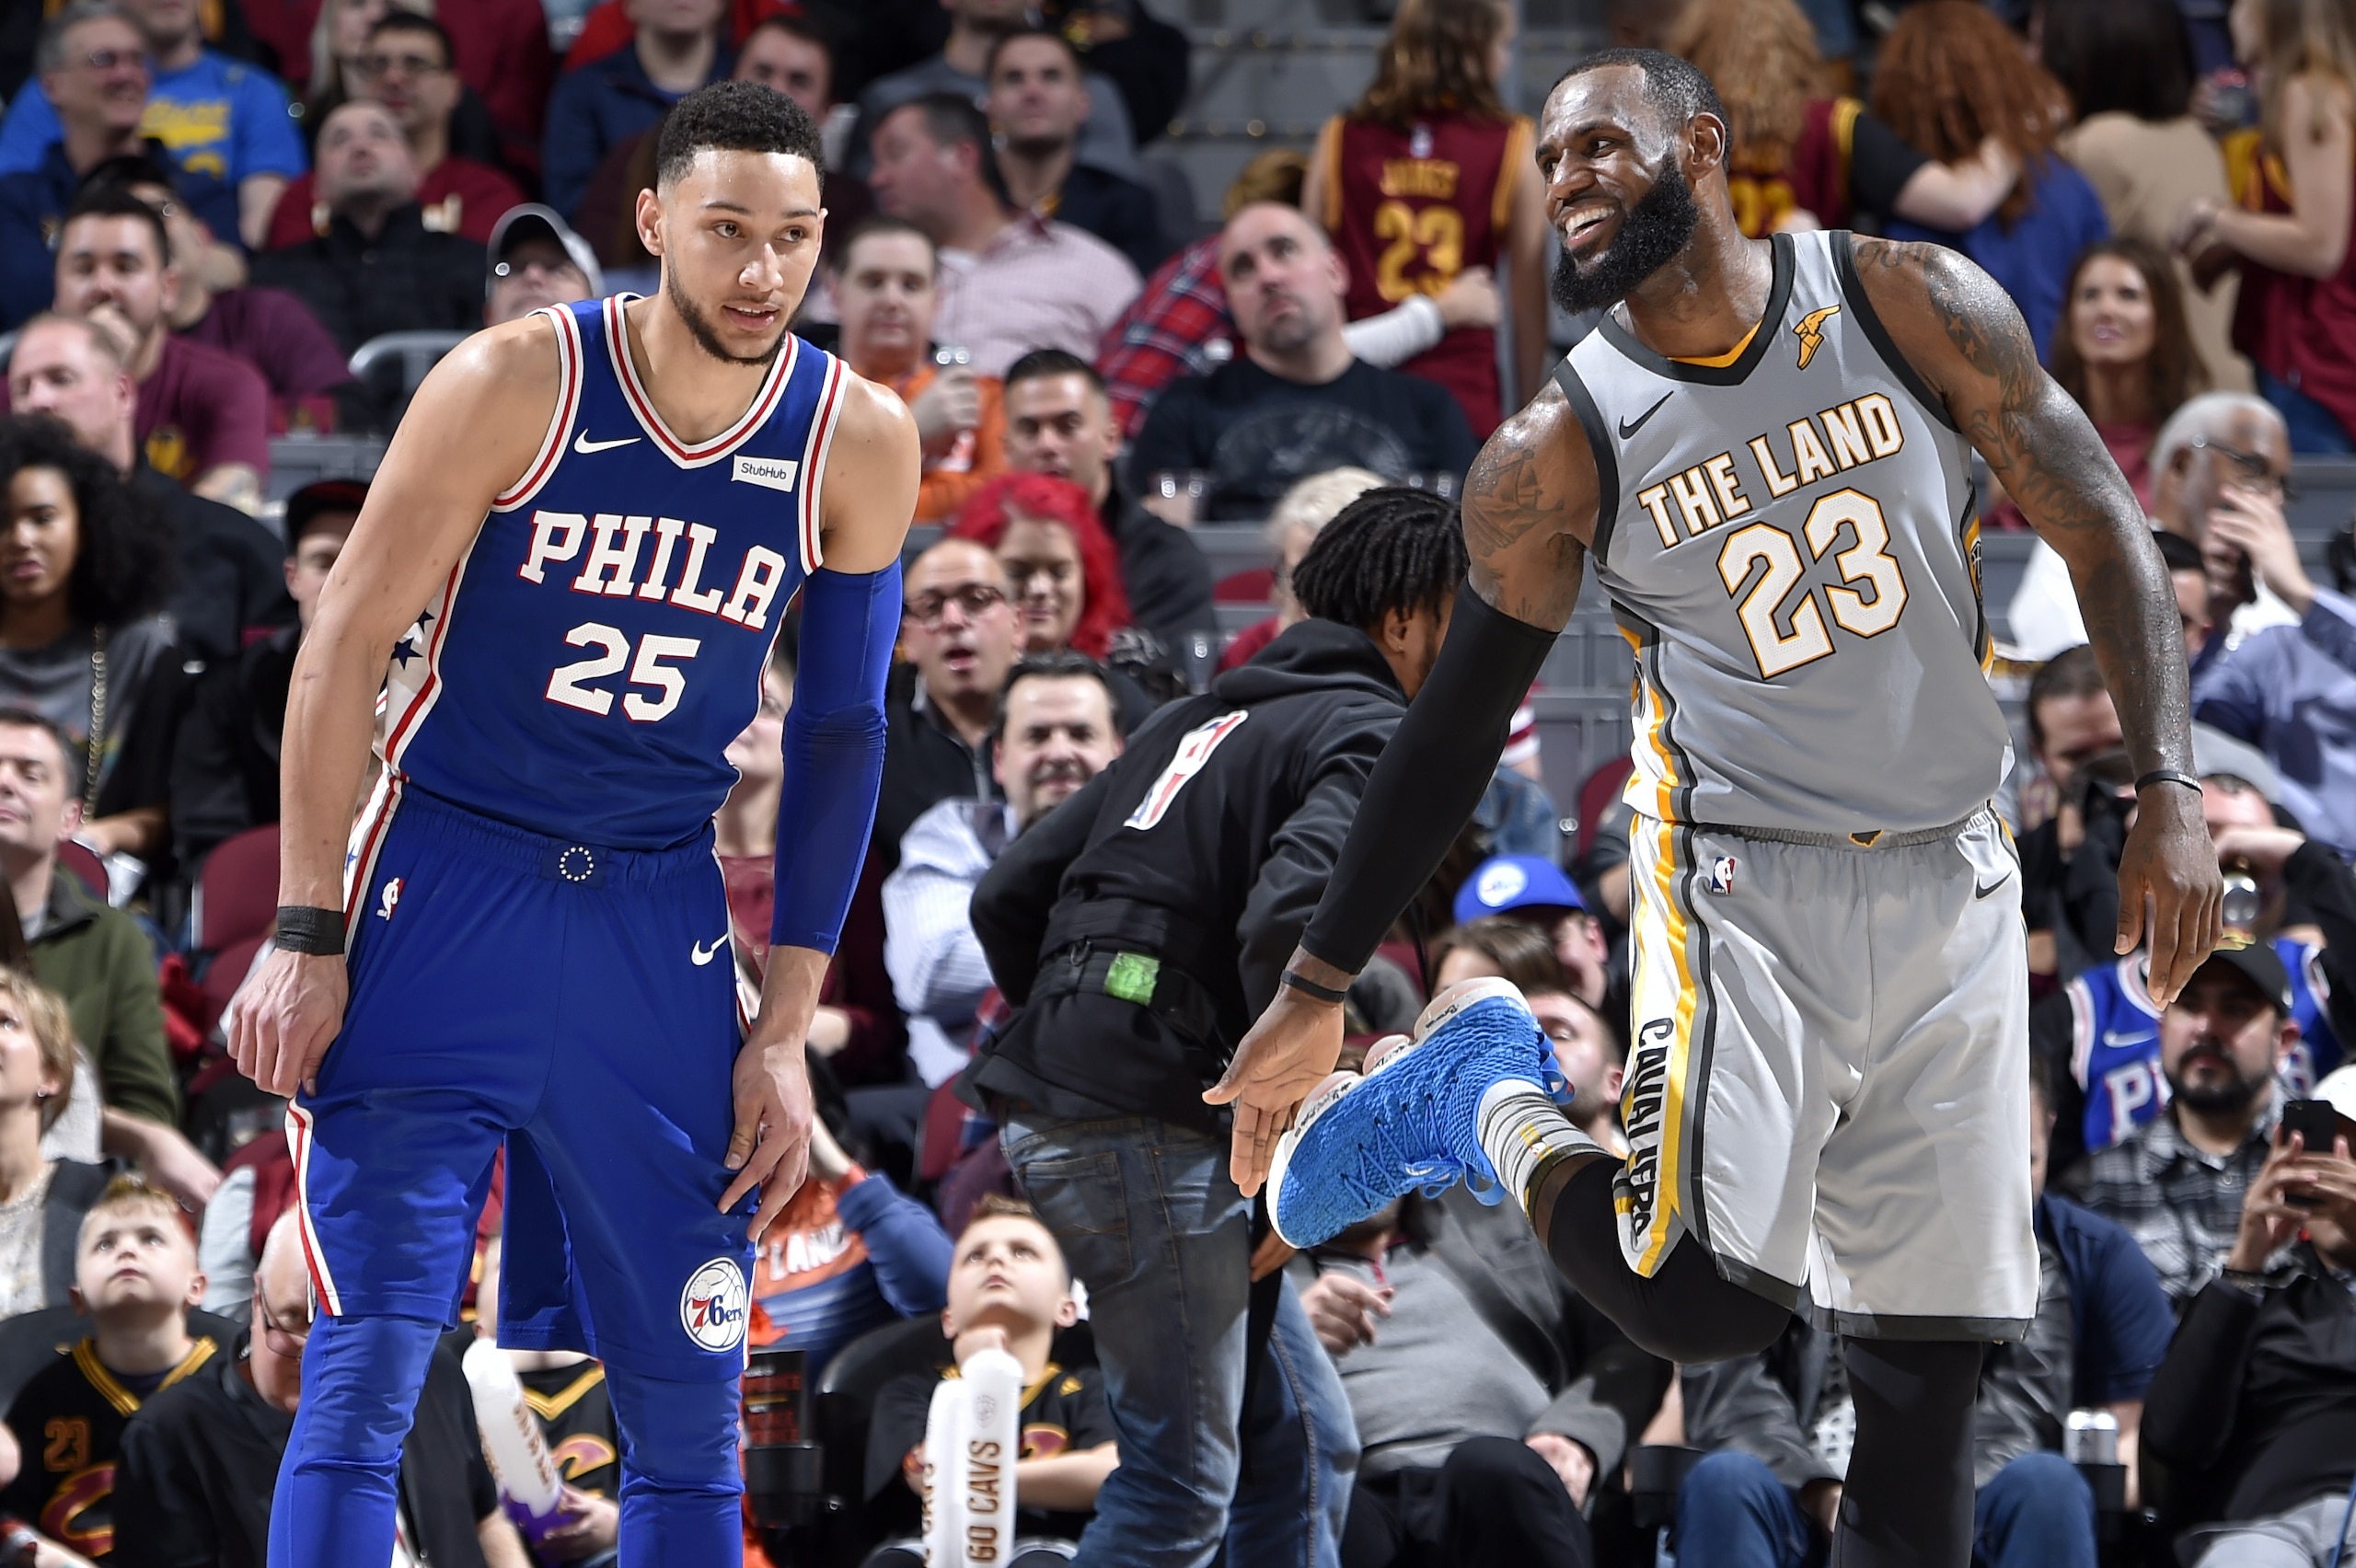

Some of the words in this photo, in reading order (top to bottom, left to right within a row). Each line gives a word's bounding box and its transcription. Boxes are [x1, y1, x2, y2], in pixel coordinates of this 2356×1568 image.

[741, 462, 787, 479] StubHub
[1636, 451, 1752, 549] THE
[1746, 392, 1904, 499] LAND
[516, 510, 786, 633] PHILA
[1715, 487, 1910, 680] 23
[544, 621, 701, 723] 25
[691, 1295, 743, 1328] 76ers
[43, 1417, 90, 1472] 23
[967, 1439, 1000, 1516] CAVS
[967, 1525, 998, 1562] GO
